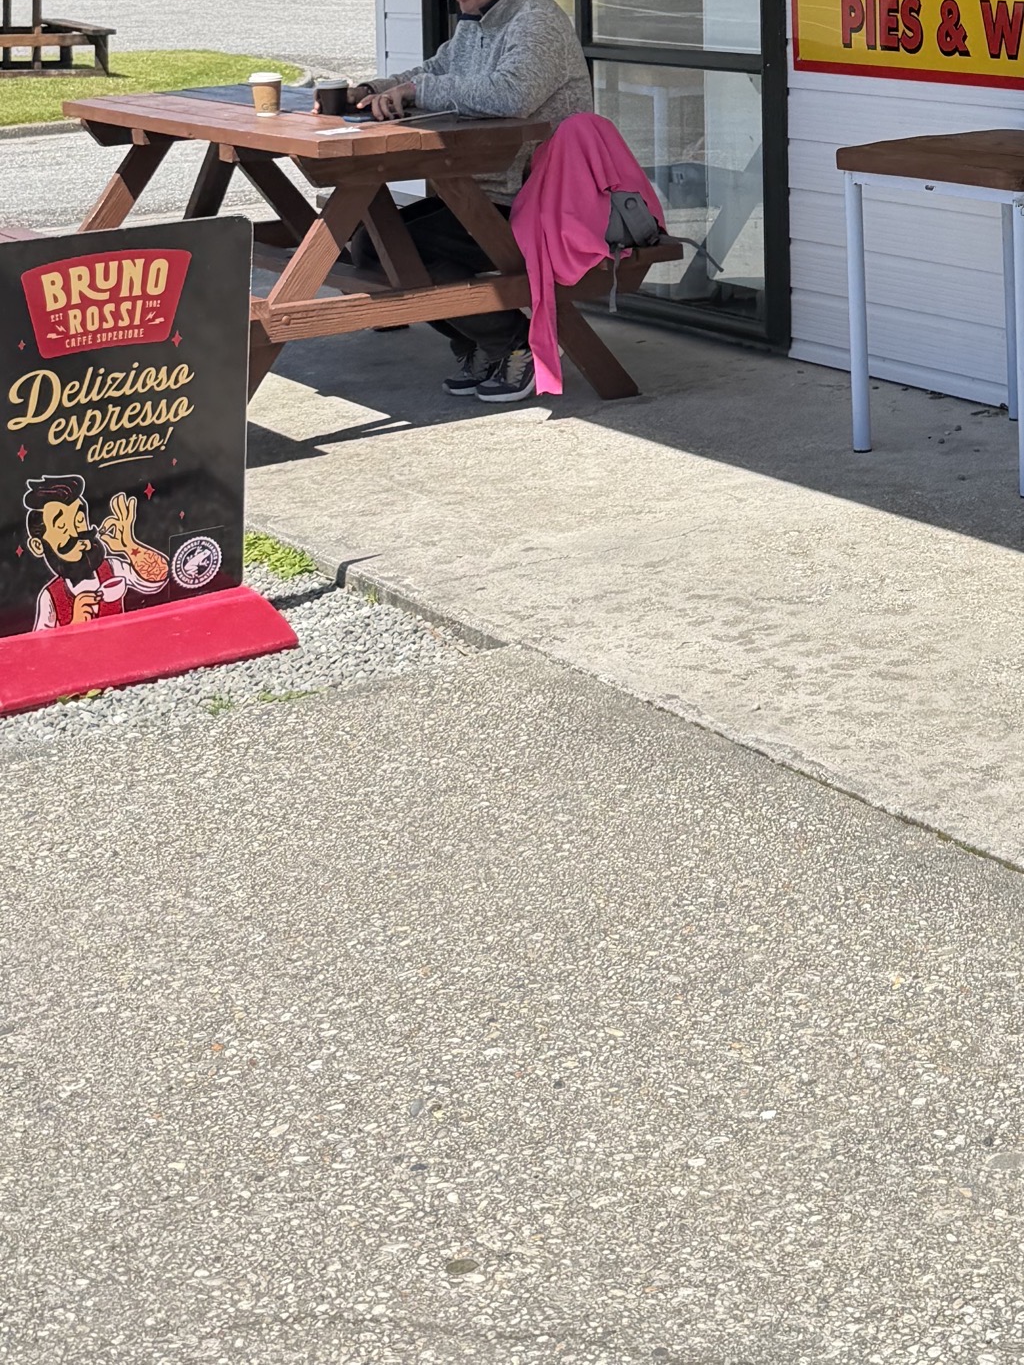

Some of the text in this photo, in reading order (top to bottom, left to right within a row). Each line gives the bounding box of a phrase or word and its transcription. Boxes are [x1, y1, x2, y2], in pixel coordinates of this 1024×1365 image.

[41, 258, 169, 312] BRUNO
[67, 299, 144, 335] ROSSI
[96, 328, 144, 343] SUPERIORE
[7, 362, 195, 431] Delizioso
[48, 396, 195, 450] espresso
[87, 426, 174, 463] dentro!
